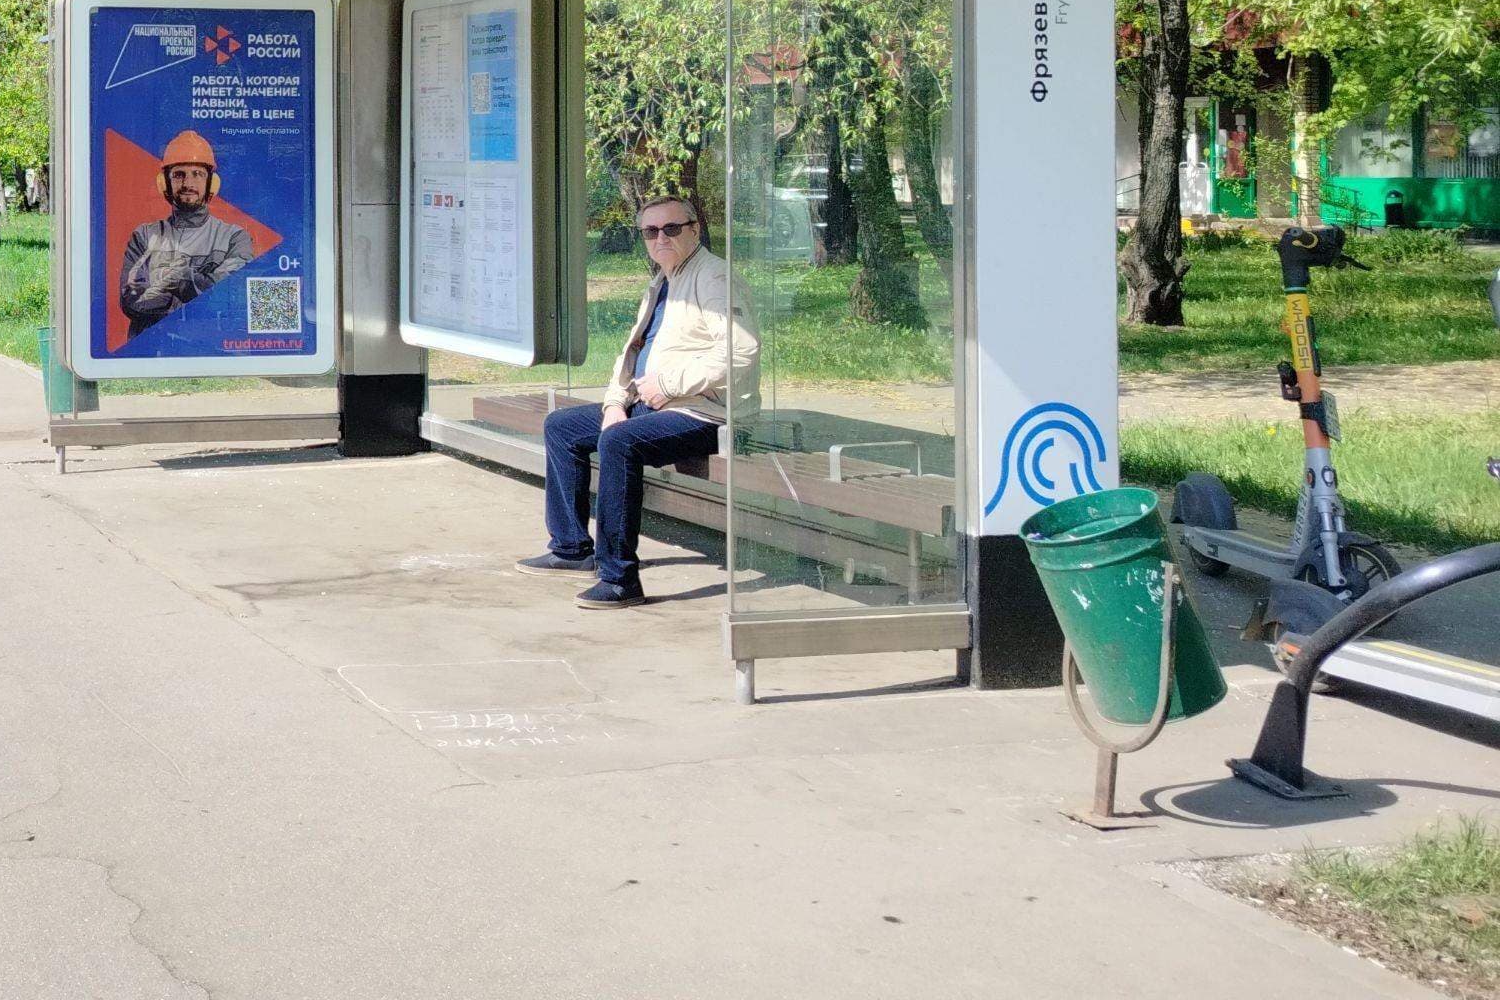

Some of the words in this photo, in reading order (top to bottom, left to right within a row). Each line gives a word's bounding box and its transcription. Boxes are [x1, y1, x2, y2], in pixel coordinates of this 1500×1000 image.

[134, 27, 194, 36] НАЦИОНАЛЬНЫЕ
[160, 38, 194, 46] ПРОЕКТЫ
[248, 34, 298, 45] РАБОТА
[166, 47, 194, 56] РОССИИ
[248, 47, 301, 58] РОССИИ
[192, 76, 243, 86] РАБОТА,
[246, 76, 300, 86] КОТОРАЯ
[192, 87, 232, 97] ИМЕЕТ
[235, 87, 301, 97] ЗНАЧЕНИЕ.
[192, 99, 247, 109] НАВЫКИ,
[192, 109, 249, 119] КОТОРЫЕ
[252, 109, 260, 119] В
[264, 109, 295, 120] ЦЕНЕ
[221, 126, 254, 136] Научим
[256, 125, 300, 135] бесплатно
[279, 255, 300, 271] 0+
[1292, 299, 1309, 369] WHOOSH
[224, 338, 302, 349] trudvsem.ru
